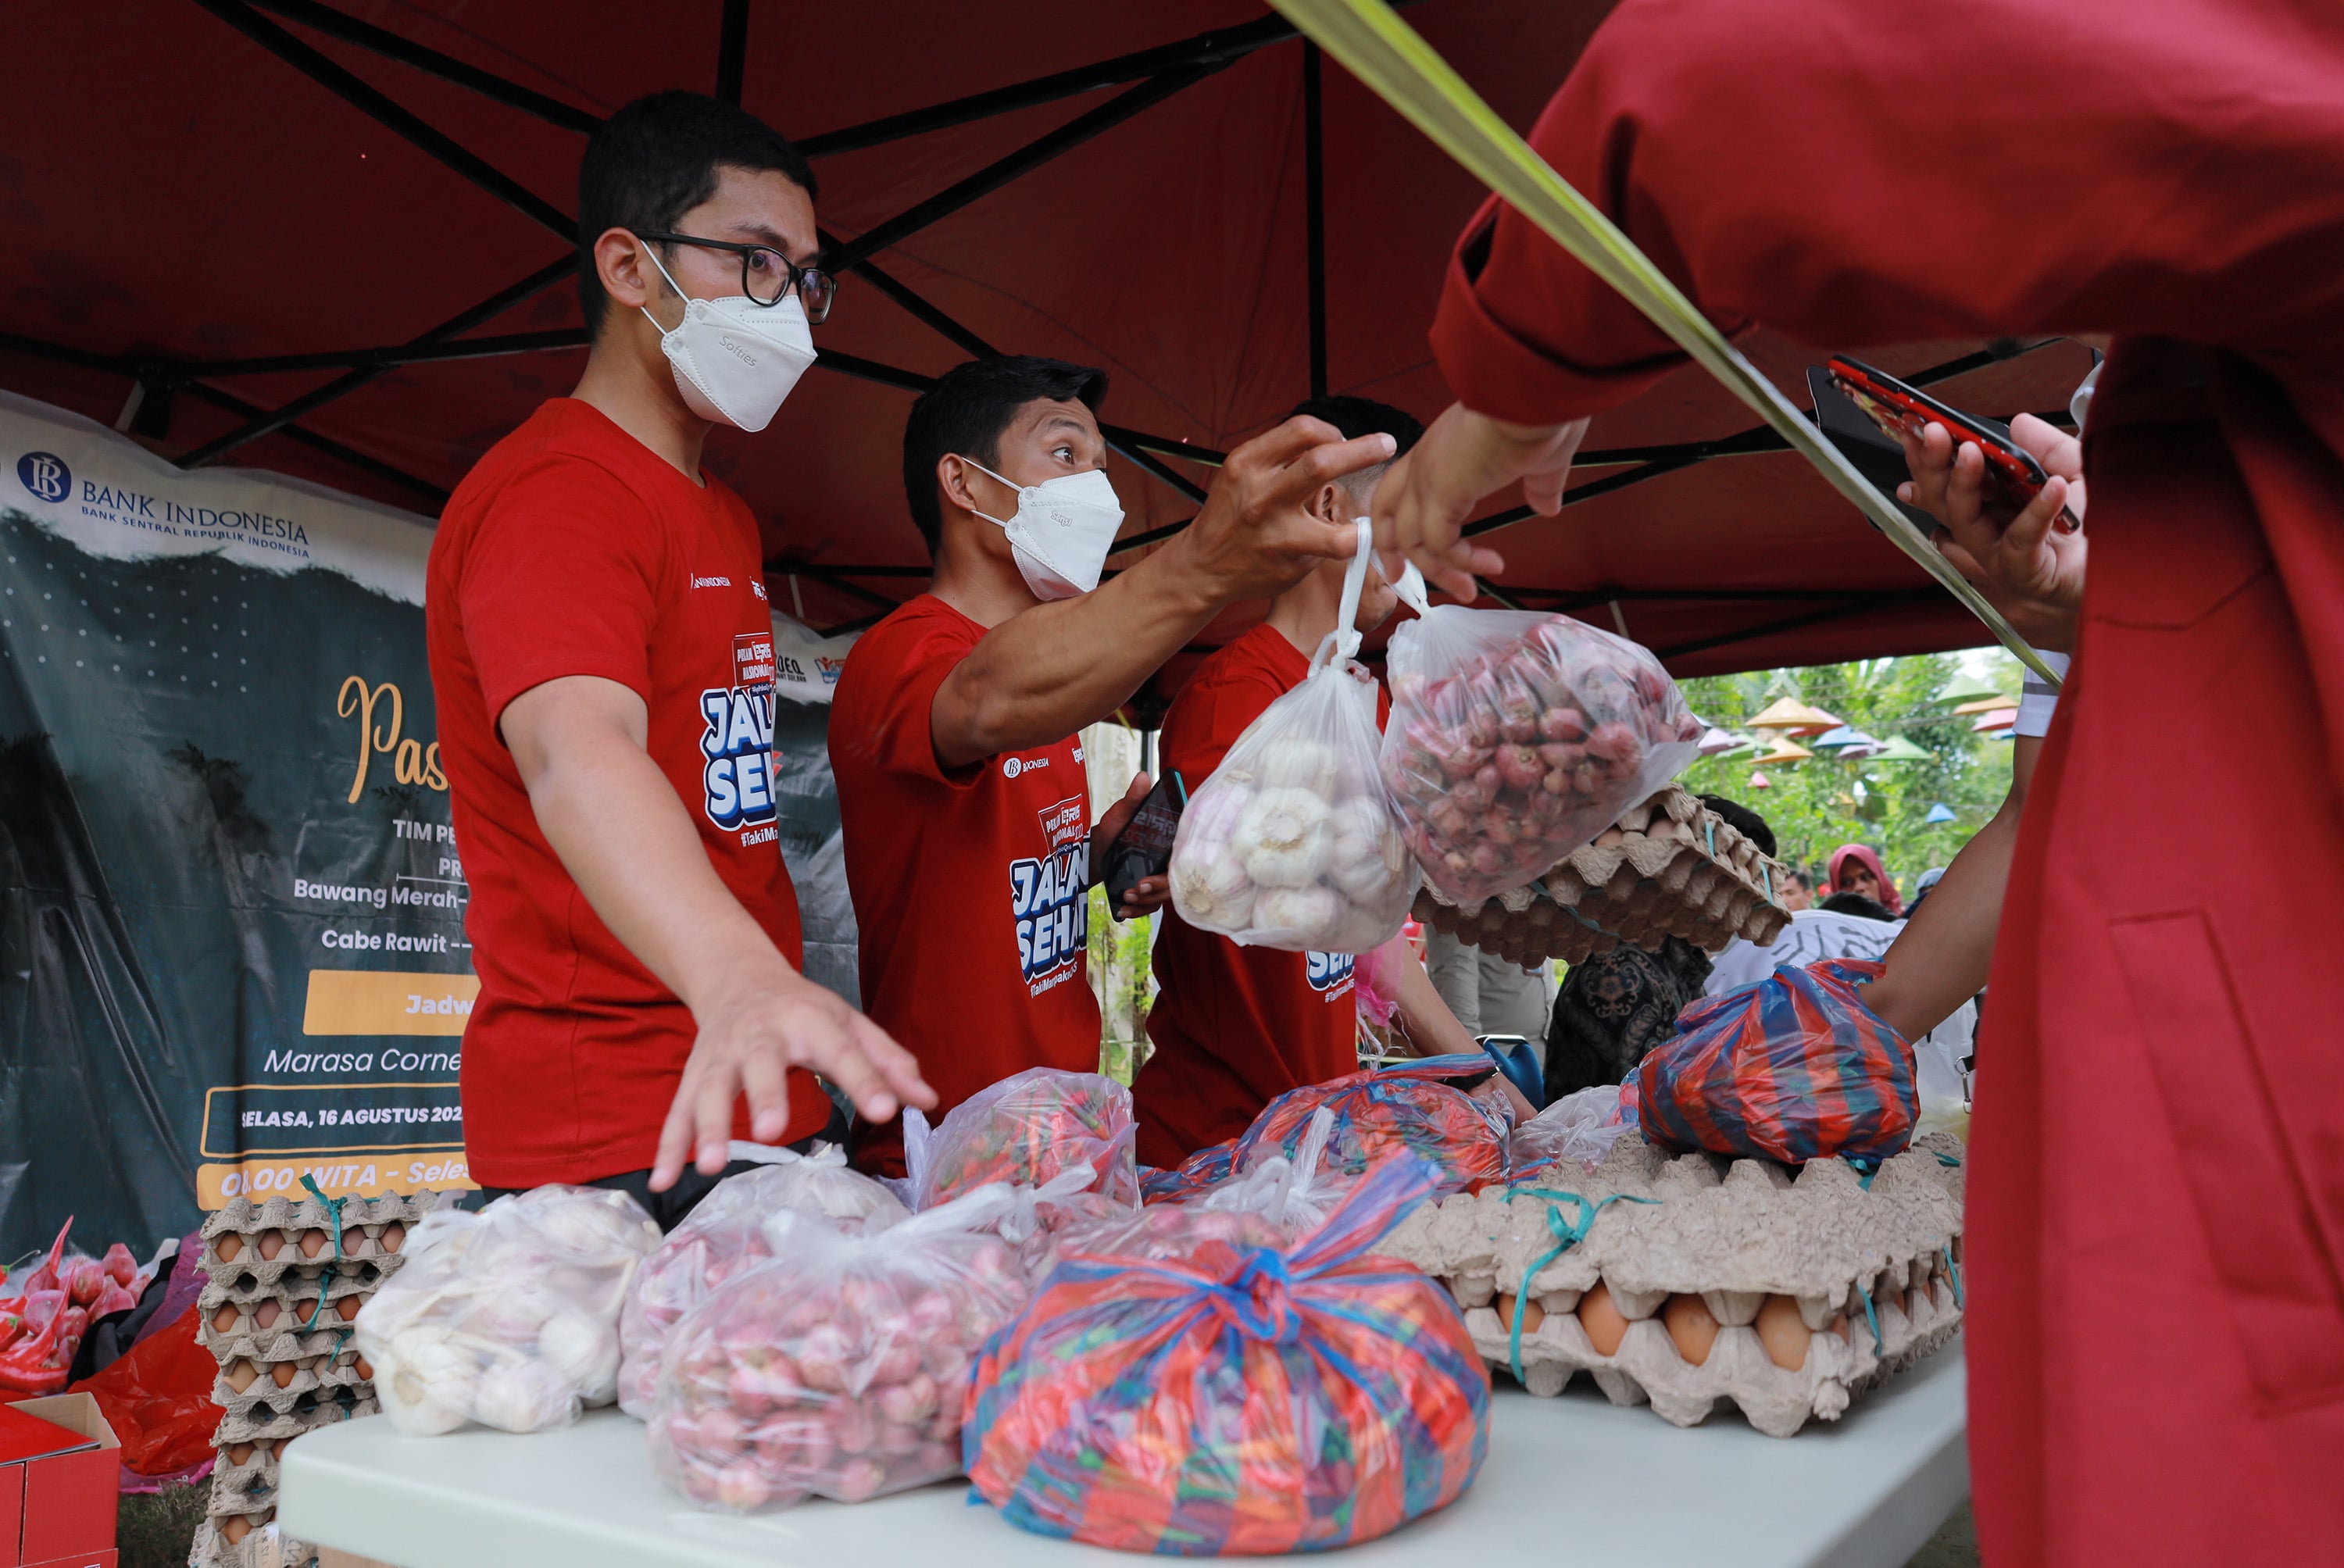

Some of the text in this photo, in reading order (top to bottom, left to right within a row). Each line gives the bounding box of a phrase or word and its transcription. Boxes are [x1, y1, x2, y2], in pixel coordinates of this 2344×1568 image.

[718, 335, 758, 368] Softies
[81, 480, 309, 545] BANK INDONESIA
[81, 505, 310, 559] BANK SENTRAL REPUBLIK INDONESIA
[704, 692, 774, 756] JAL
[392, 819, 432, 841] TIM
[294, 878, 388, 909] Bawang
[321, 930, 381, 950] Cabe
[385, 933, 447, 953] Rawit
[405, 994, 476, 1015] Jadw
[263, 1048, 462, 1073] Marasa Corne
[241, 1110, 314, 1128] SELASA,
[318, 1109, 338, 1126] 16
[340, 1107, 429, 1125] AGUSTUS
[220, 1167, 295, 1197] 08.00
[304, 1164, 376, 1189] WITA
